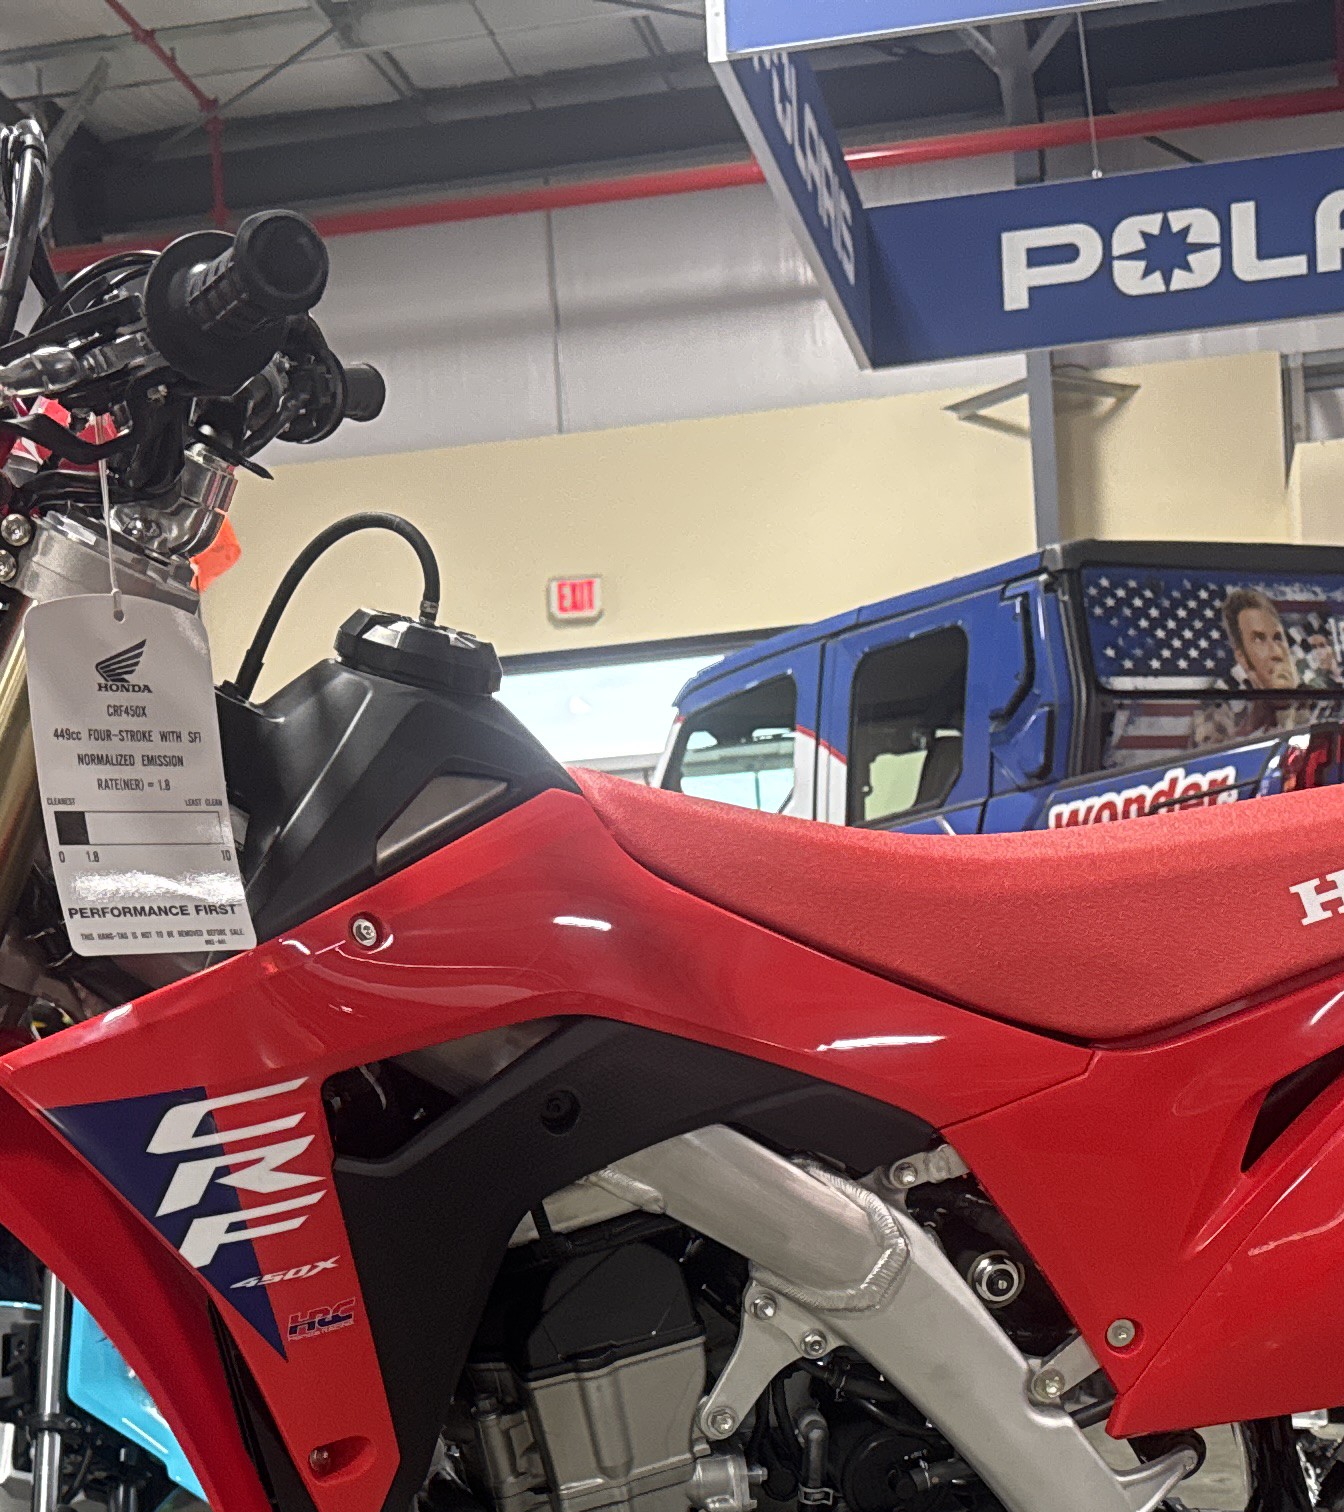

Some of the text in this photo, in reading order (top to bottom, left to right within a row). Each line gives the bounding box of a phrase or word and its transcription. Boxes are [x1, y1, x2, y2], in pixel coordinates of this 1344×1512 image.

[557, 580, 595, 613] EXIT
[97, 682, 153, 694] HONDA
[106, 704, 148, 718] CRF450X
[53, 728, 202, 743] 449cc FOUR-STROKE WITH SFI
[77, 753, 184, 767] NORMALIZED EMISSION
[97, 778, 145, 791] RATE(NER)
[158, 779, 171, 791] 1.8
[184, 798, 202, 807] LEAST
[58, 851, 66, 863] 0
[86, 851, 100, 863] 1.8
[221, 849, 232, 862] 10
[68, 903, 237, 919] PERFORMANCE FIRST
[145, 1076, 328, 1269] CRF
[229, 1255, 340, 1288] 450X
[287, 1297, 355, 1337] HRC
